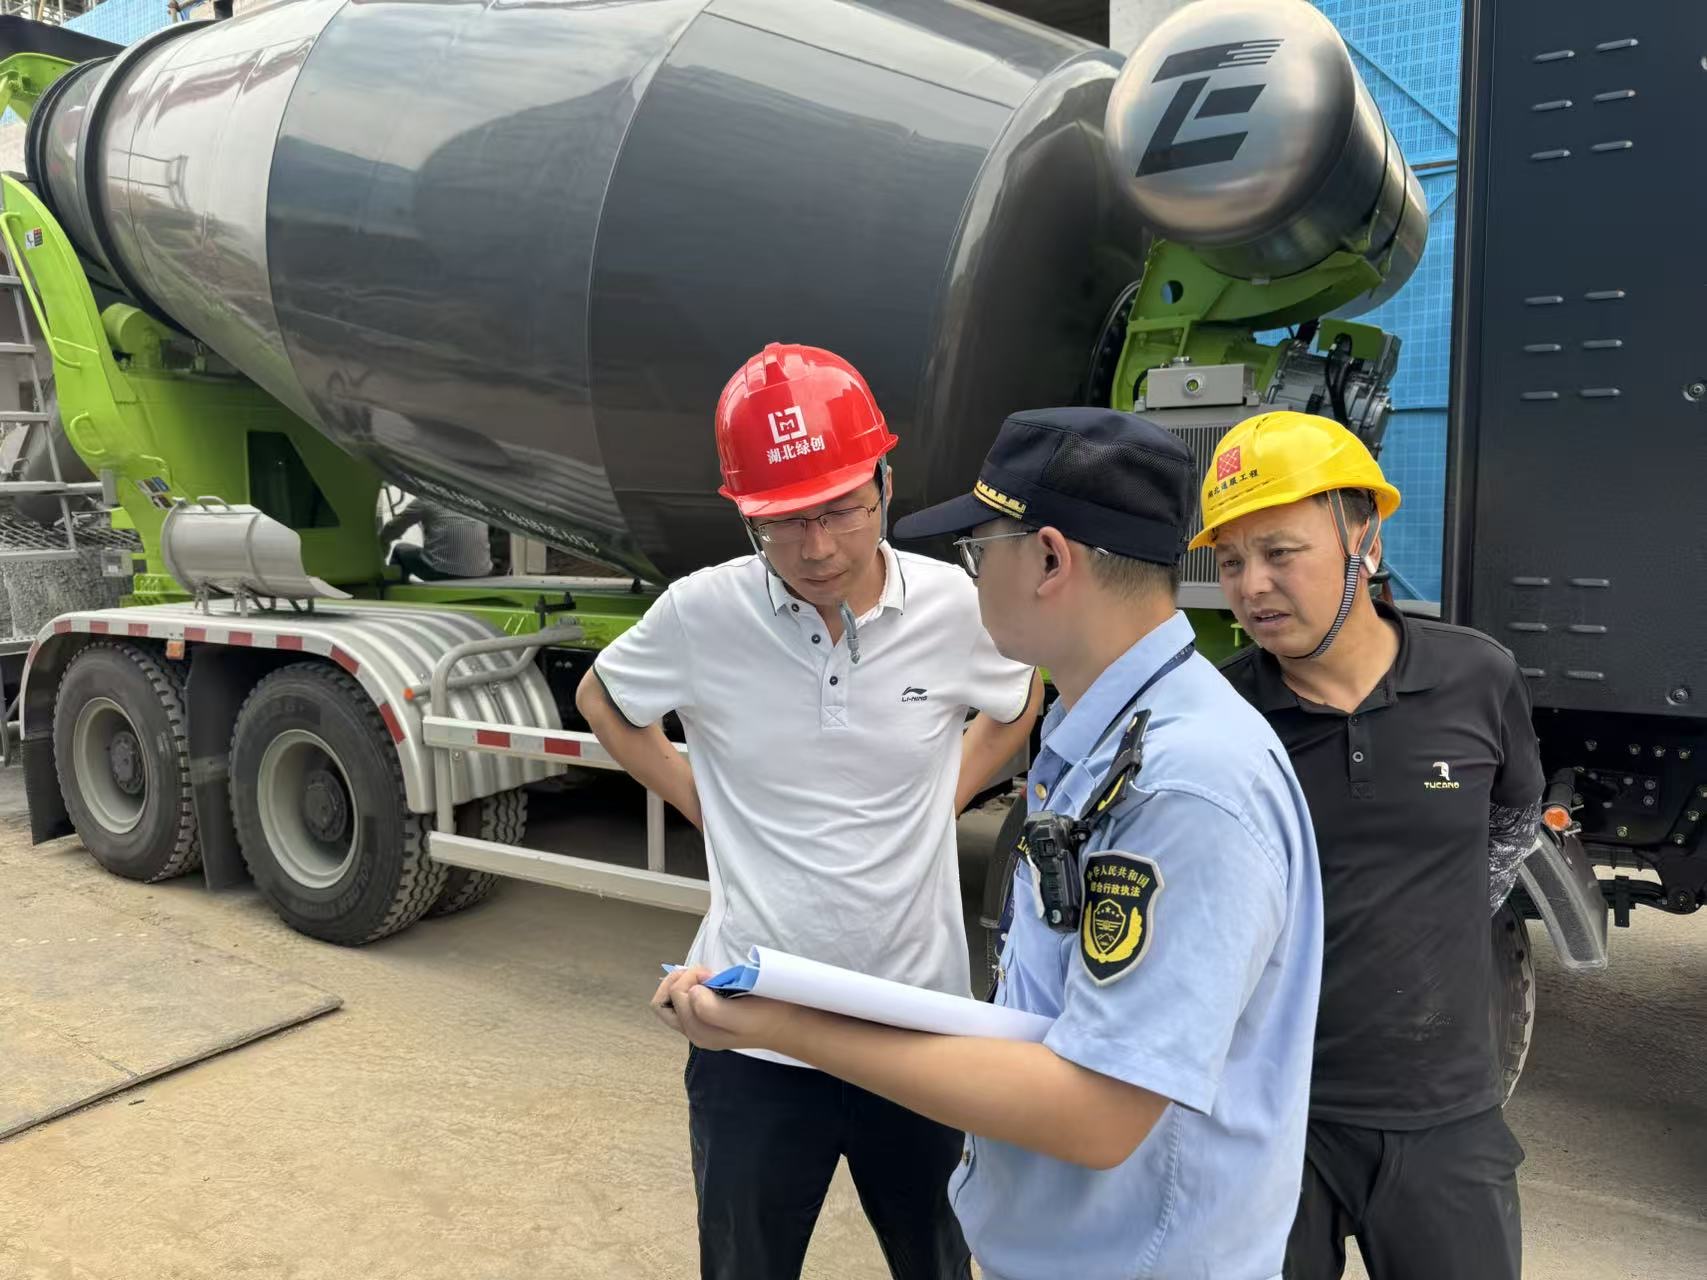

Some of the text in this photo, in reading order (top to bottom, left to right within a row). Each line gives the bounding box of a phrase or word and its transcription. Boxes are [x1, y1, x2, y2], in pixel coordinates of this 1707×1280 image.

[766, 435, 826, 464] 湖北绿创
[1423, 781, 1460, 789] TUCANO
[1087, 864, 1150, 889] 中华人民共和国
